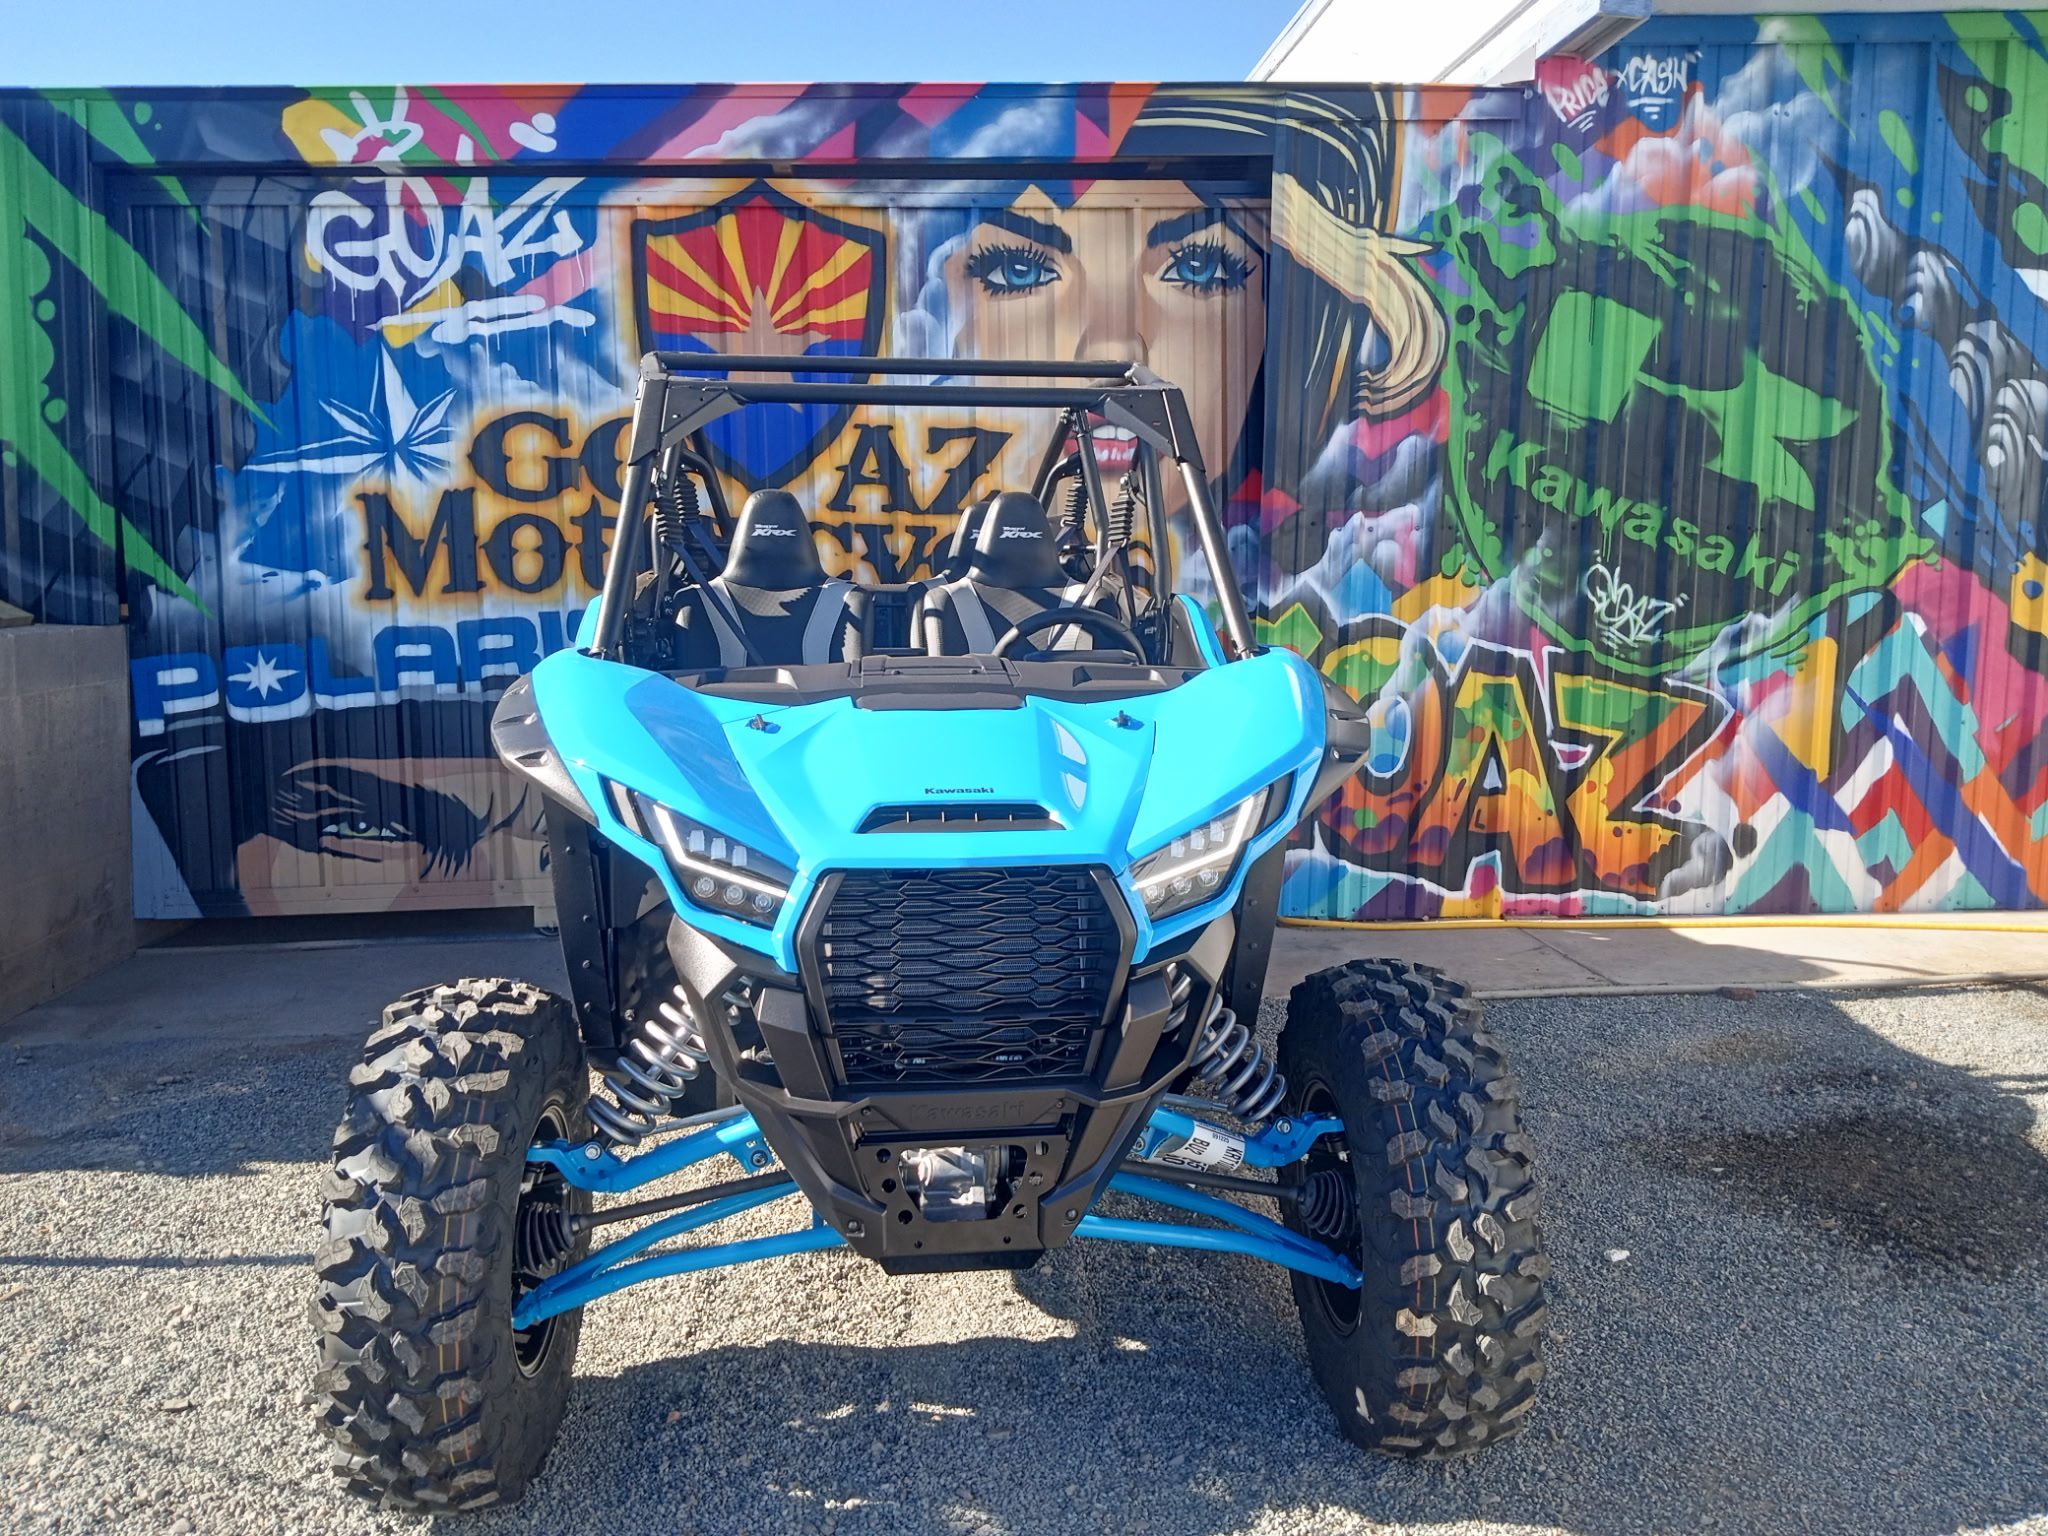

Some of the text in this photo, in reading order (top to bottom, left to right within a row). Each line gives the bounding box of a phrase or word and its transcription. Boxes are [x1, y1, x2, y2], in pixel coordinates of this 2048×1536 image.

[827, 423, 1013, 515] AZ
[1480, 429, 1800, 597] Kawasaki
[130, 609, 588, 738] POLARI
[925, 787, 995, 795] Kawasaki
